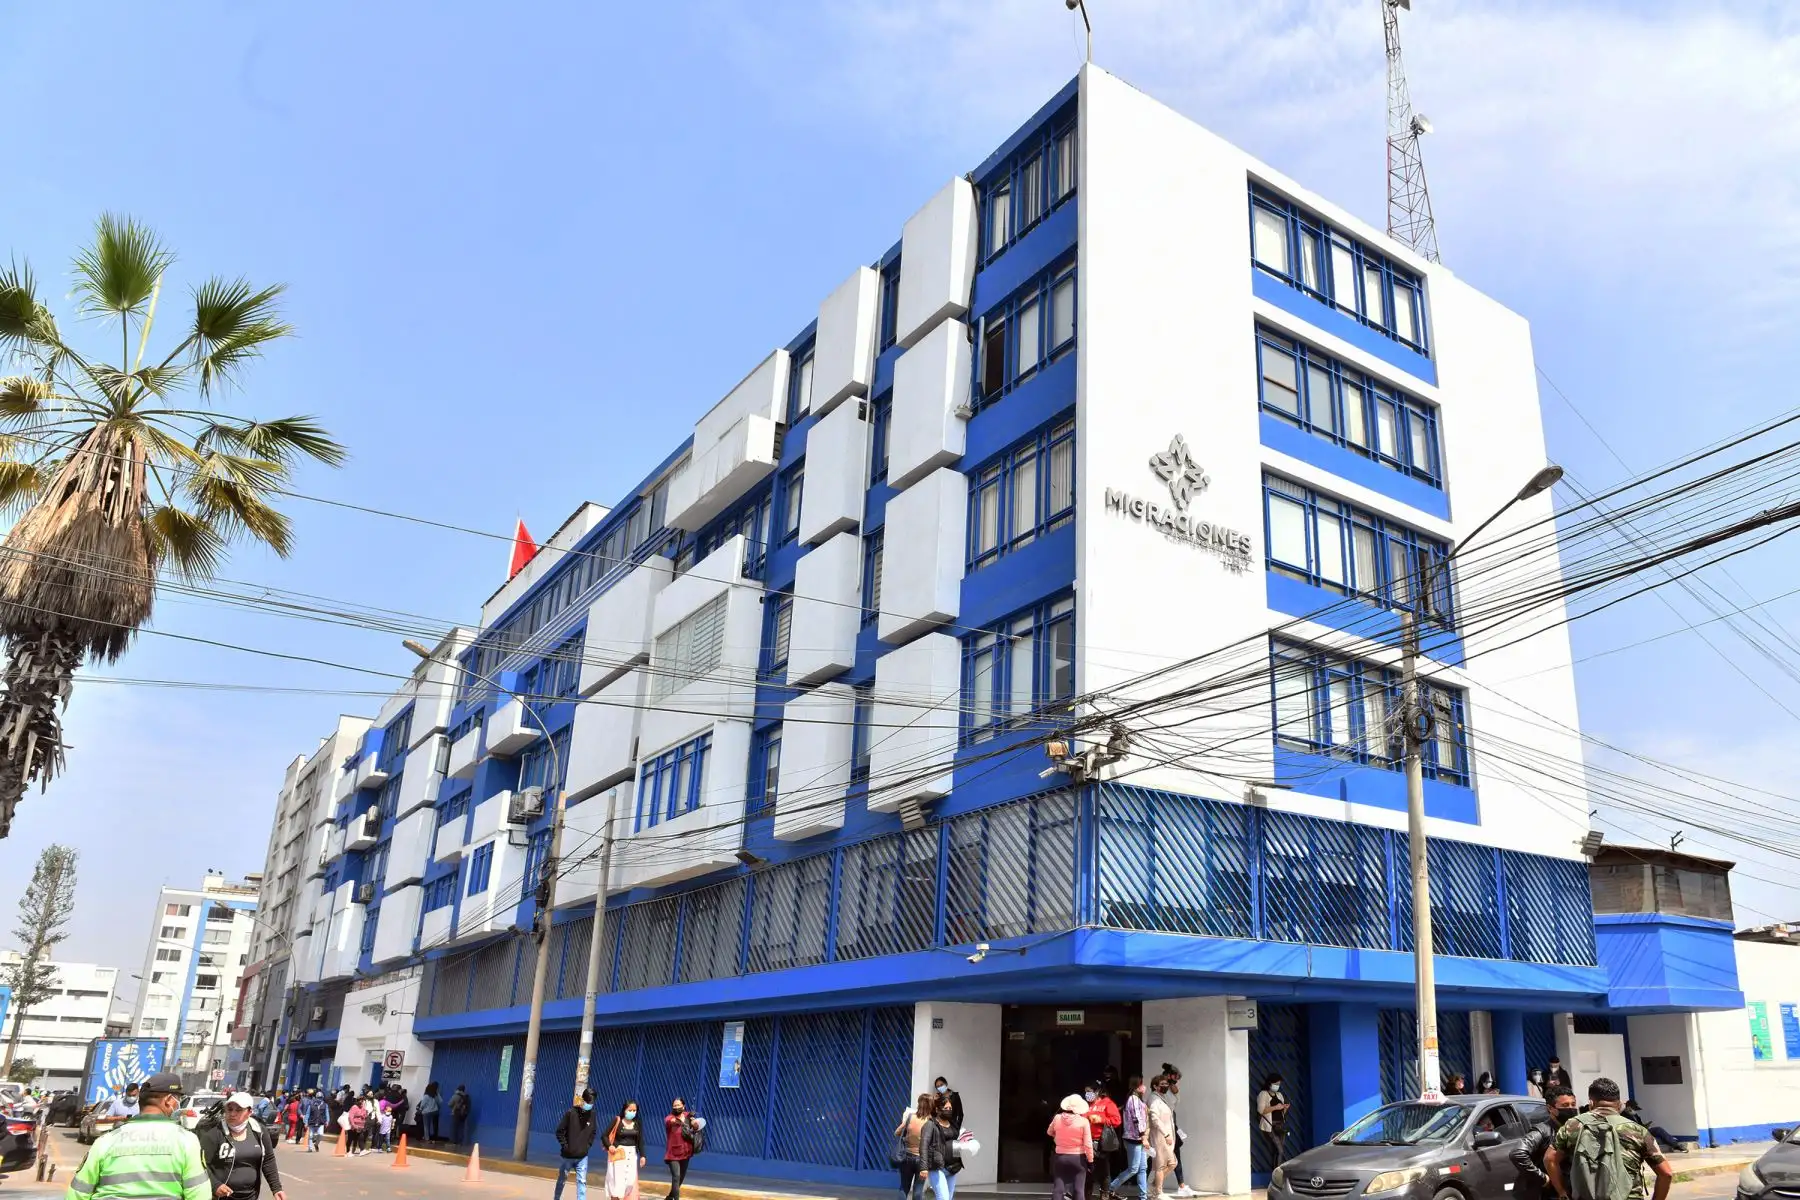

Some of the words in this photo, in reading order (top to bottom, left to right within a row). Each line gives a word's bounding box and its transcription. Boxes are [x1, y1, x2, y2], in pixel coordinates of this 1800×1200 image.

[1105, 487, 1252, 555] MIGRACIONES
[1059, 1013, 1082, 1021] SALIDA
[1247, 1008, 1255, 1018] 3
[1423, 1093, 1438, 1101] TAXI
